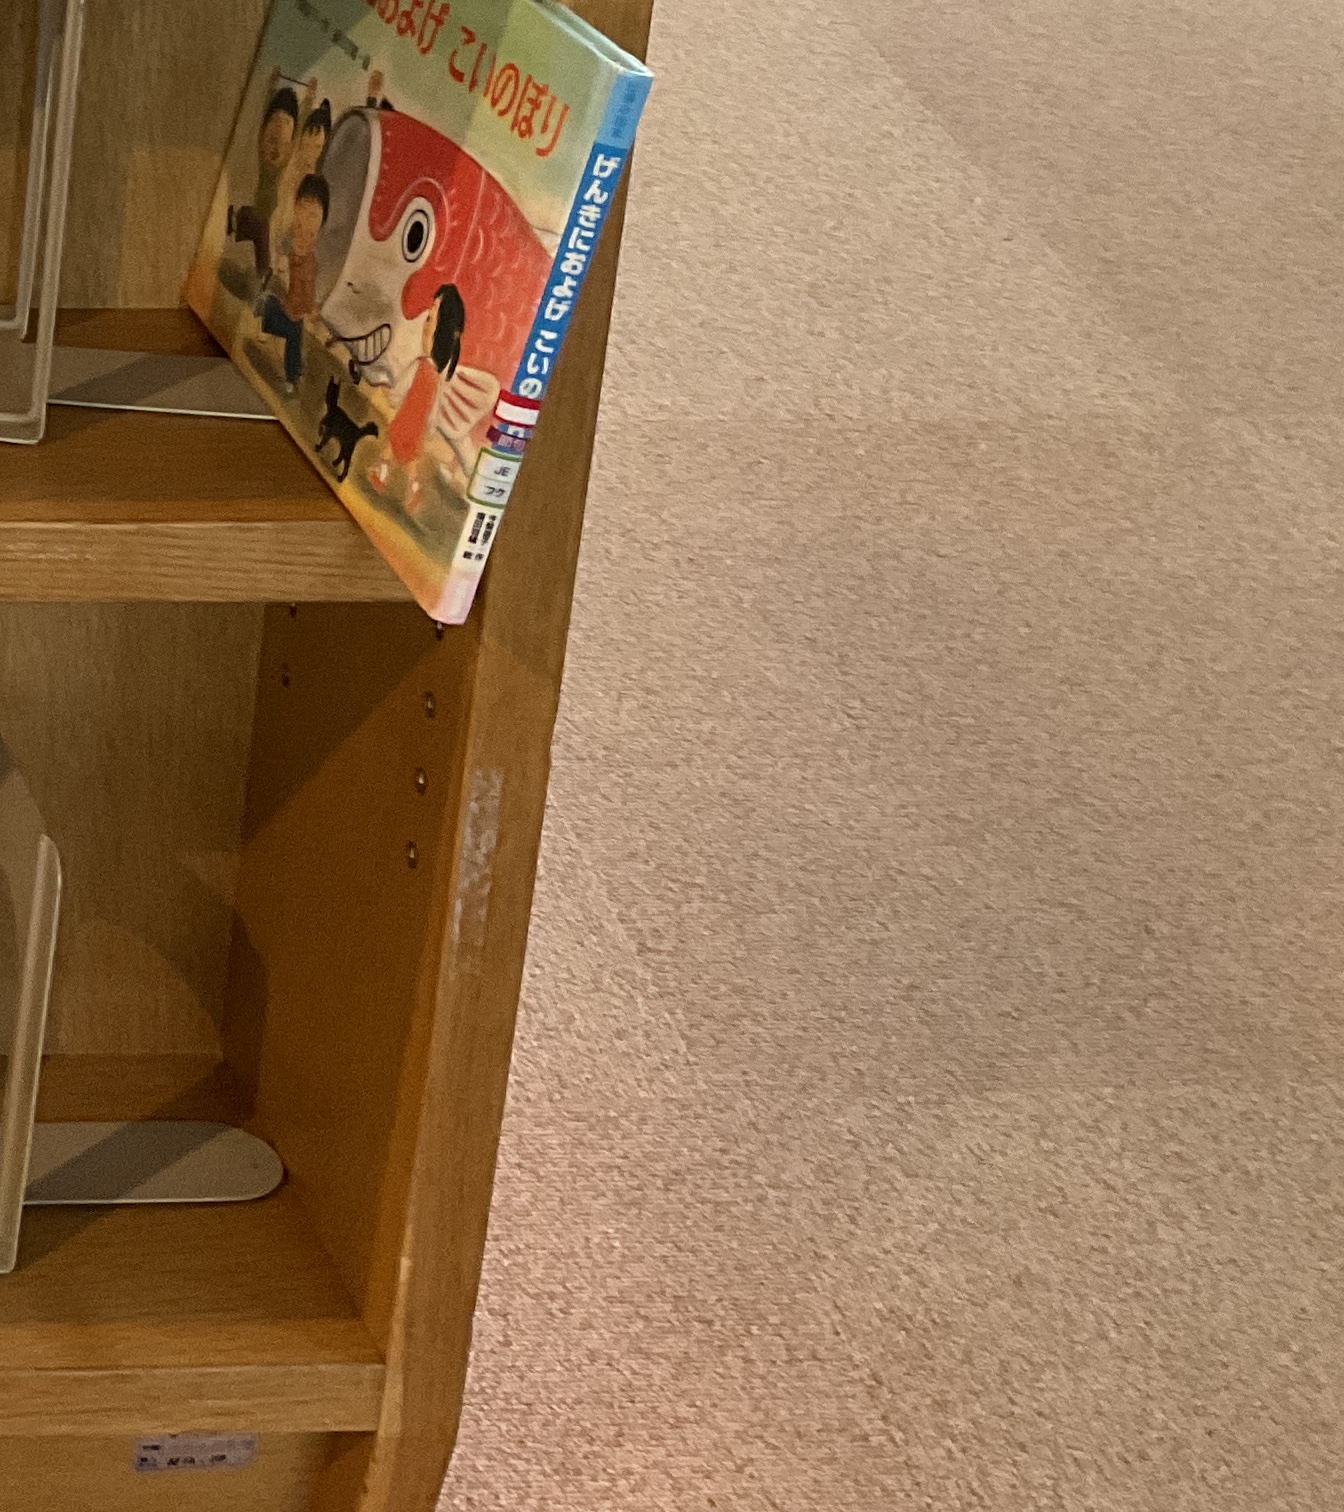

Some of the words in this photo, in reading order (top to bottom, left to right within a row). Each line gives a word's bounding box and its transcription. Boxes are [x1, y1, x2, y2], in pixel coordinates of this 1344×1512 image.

[447, 25, 571, 158] こいのぼり
[543, 152, 623, 323] げんきにおよげ
[518, 328, 560, 399] こいの
[484, 485, 506, 498] フク
[493, 466, 511, 478] JE
